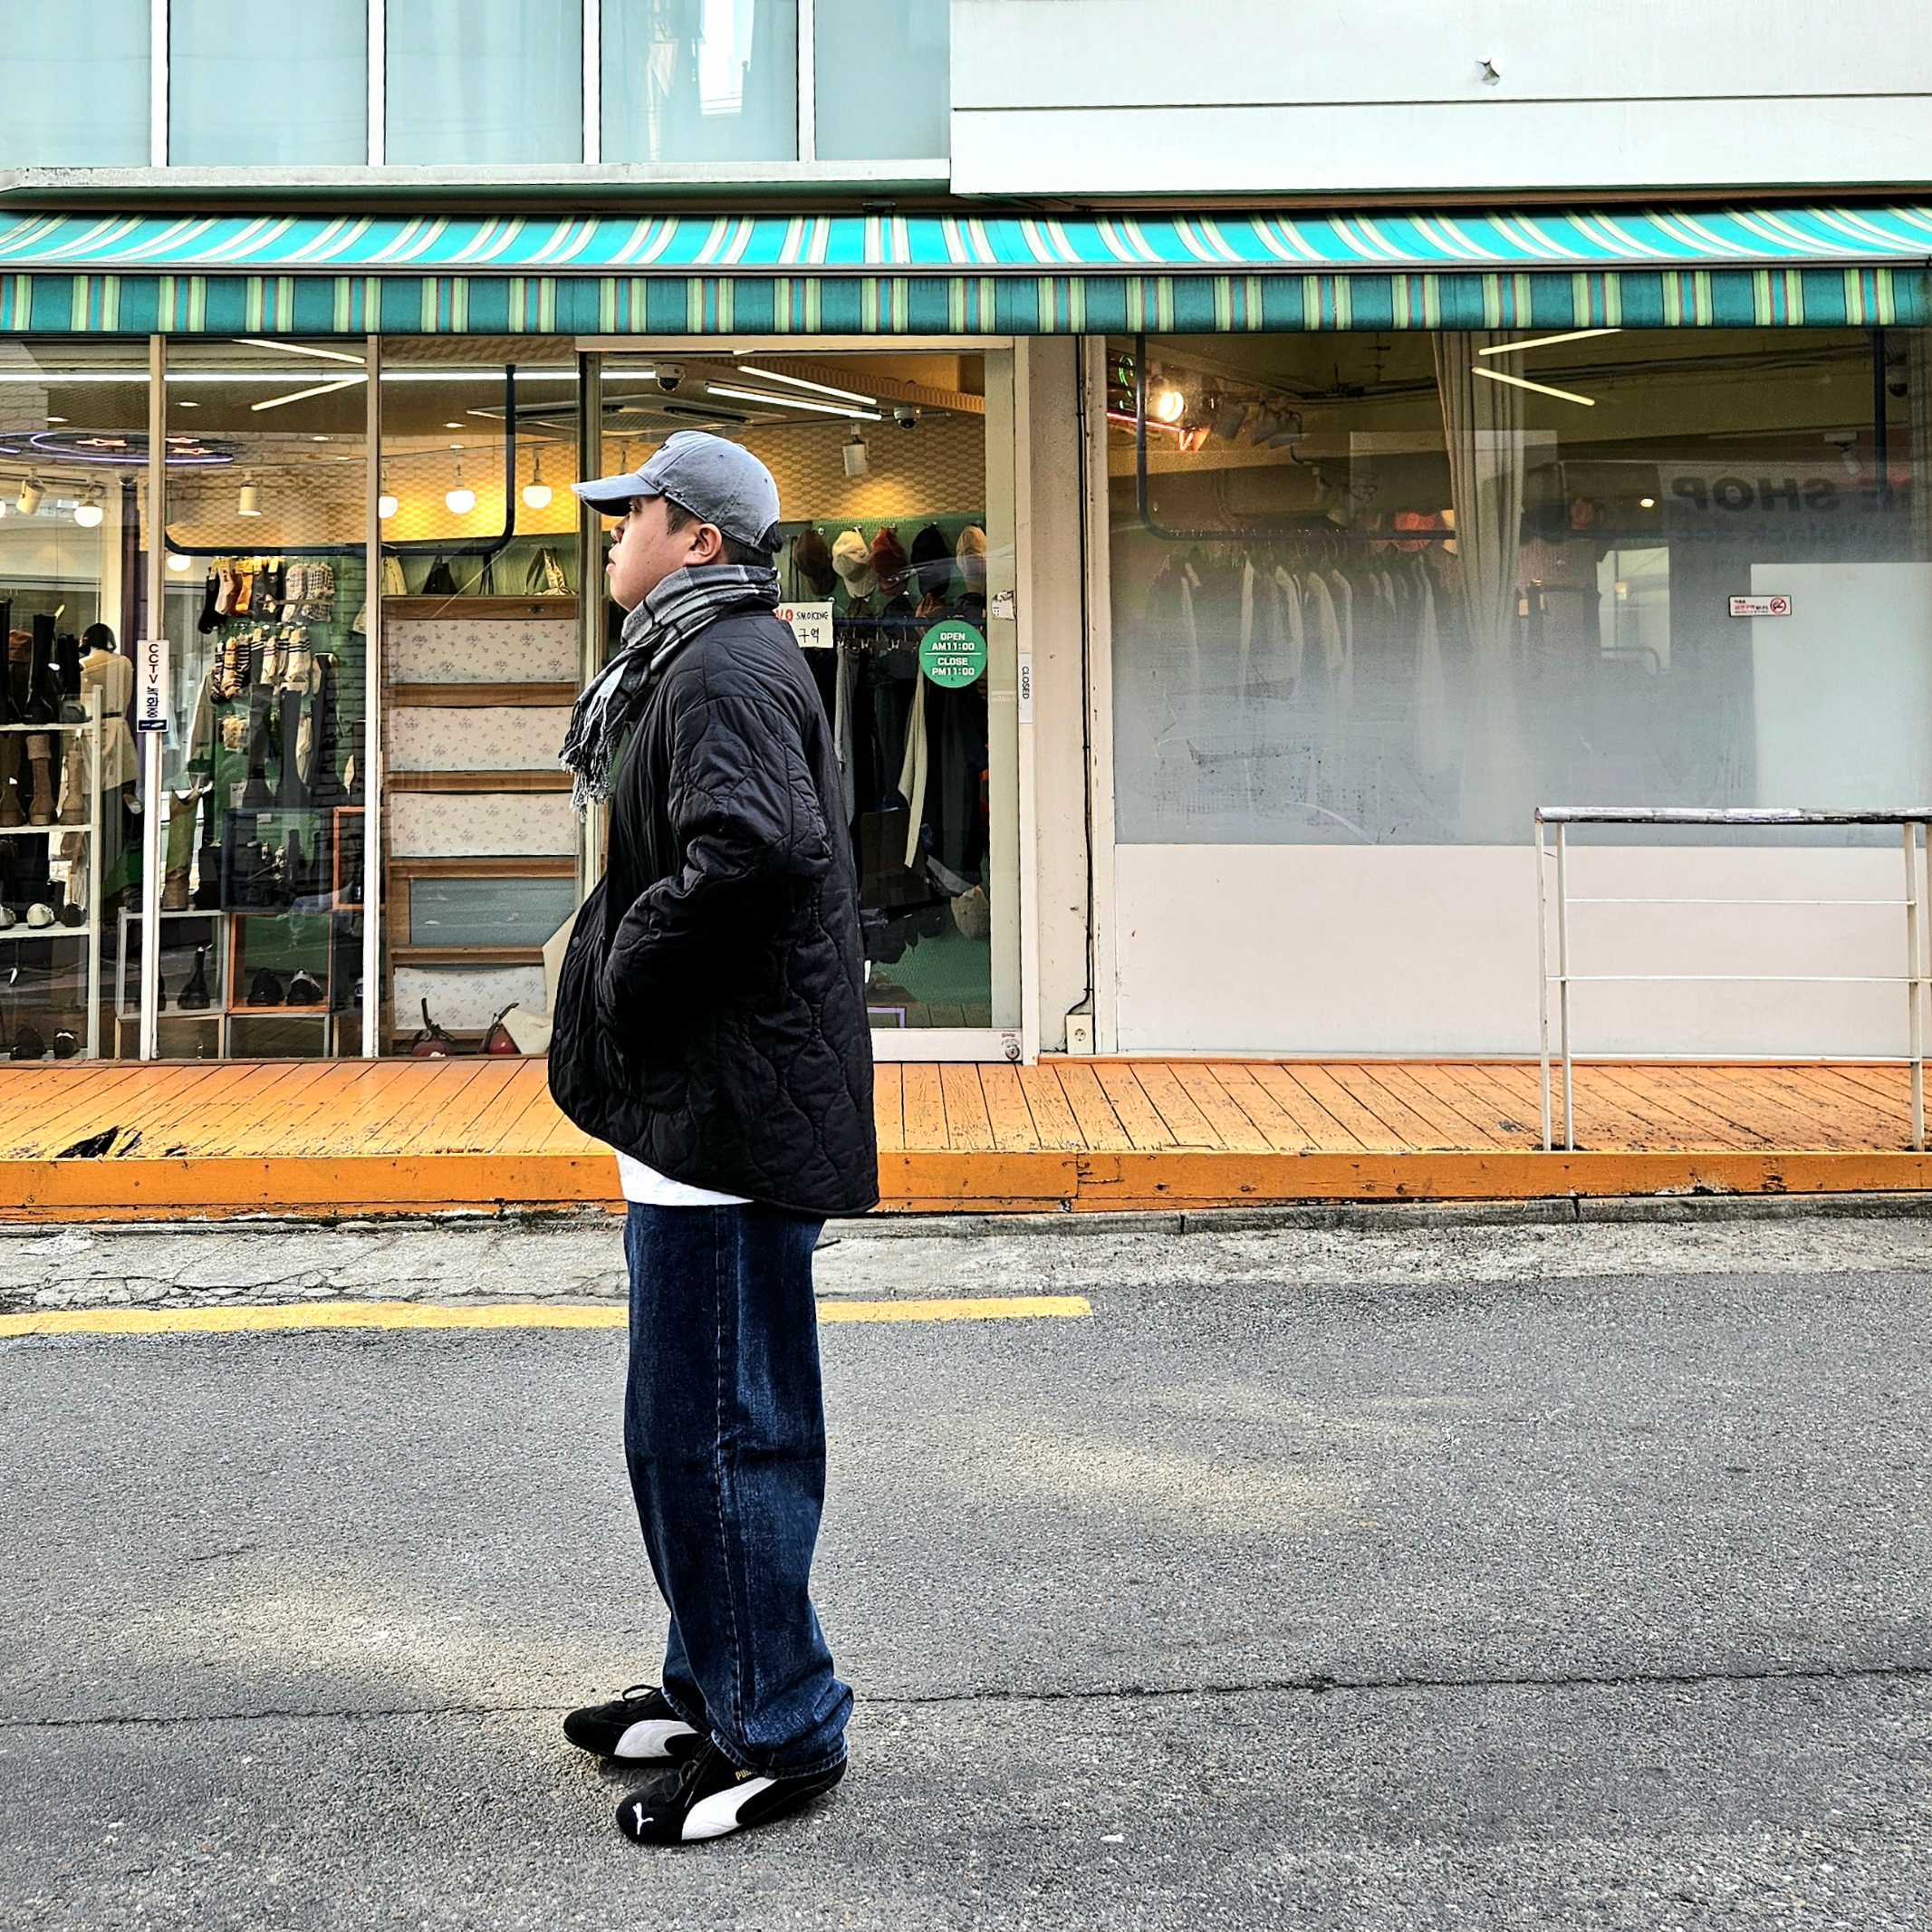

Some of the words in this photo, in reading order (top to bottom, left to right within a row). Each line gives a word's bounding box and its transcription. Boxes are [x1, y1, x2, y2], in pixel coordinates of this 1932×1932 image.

[796, 611, 829, 620] SMOKING
[798, 627, 820, 643] 구역
[940, 632, 966, 640] OPEN
[931, 642, 975, 650] AM11:00
[149, 643, 159, 684] CCTV
[937, 658, 968, 666] CLOSE
[931, 668, 975, 676] PM11:00
[1022, 666, 1030, 699] CLOSED
[146, 686, 159, 718] 녹화중
